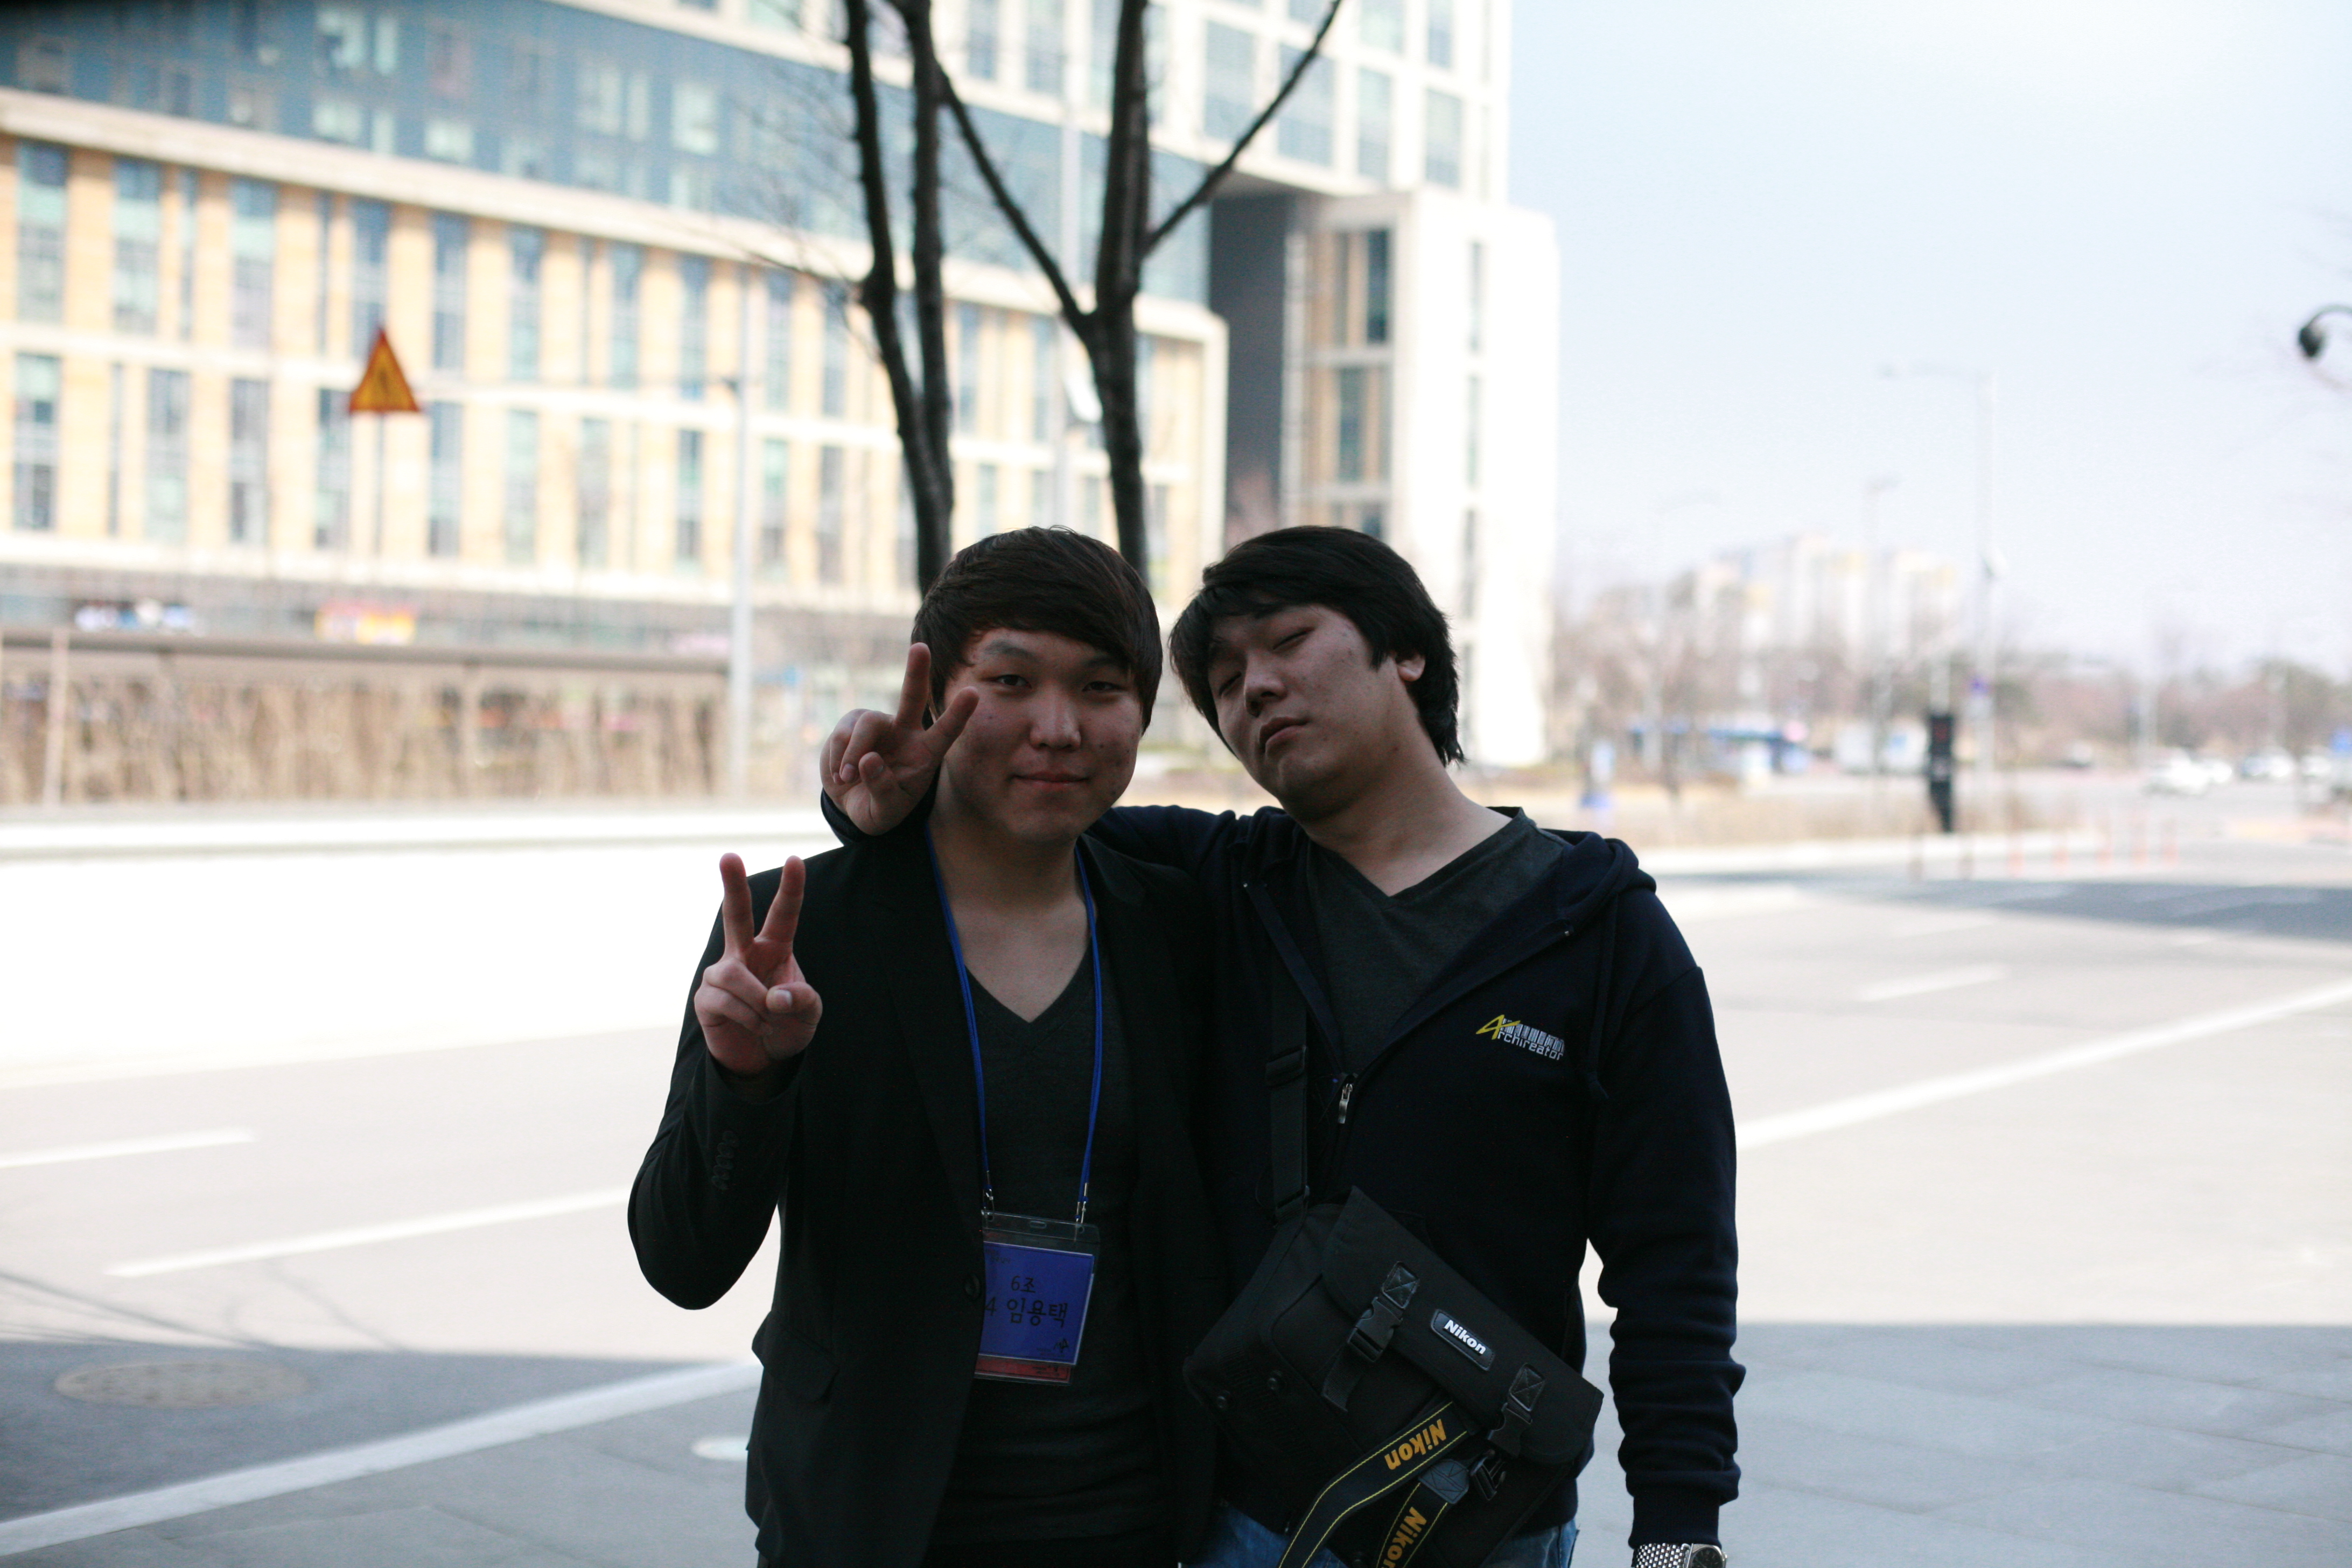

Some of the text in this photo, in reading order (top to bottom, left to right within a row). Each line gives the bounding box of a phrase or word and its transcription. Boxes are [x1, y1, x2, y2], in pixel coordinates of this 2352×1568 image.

[1011, 1276, 1036, 1293] 6조
[1007, 1298, 1068, 1328] 임용택
[1444, 1320, 1487, 1355] Nikon
[1384, 1419, 1447, 1470] Nikon
